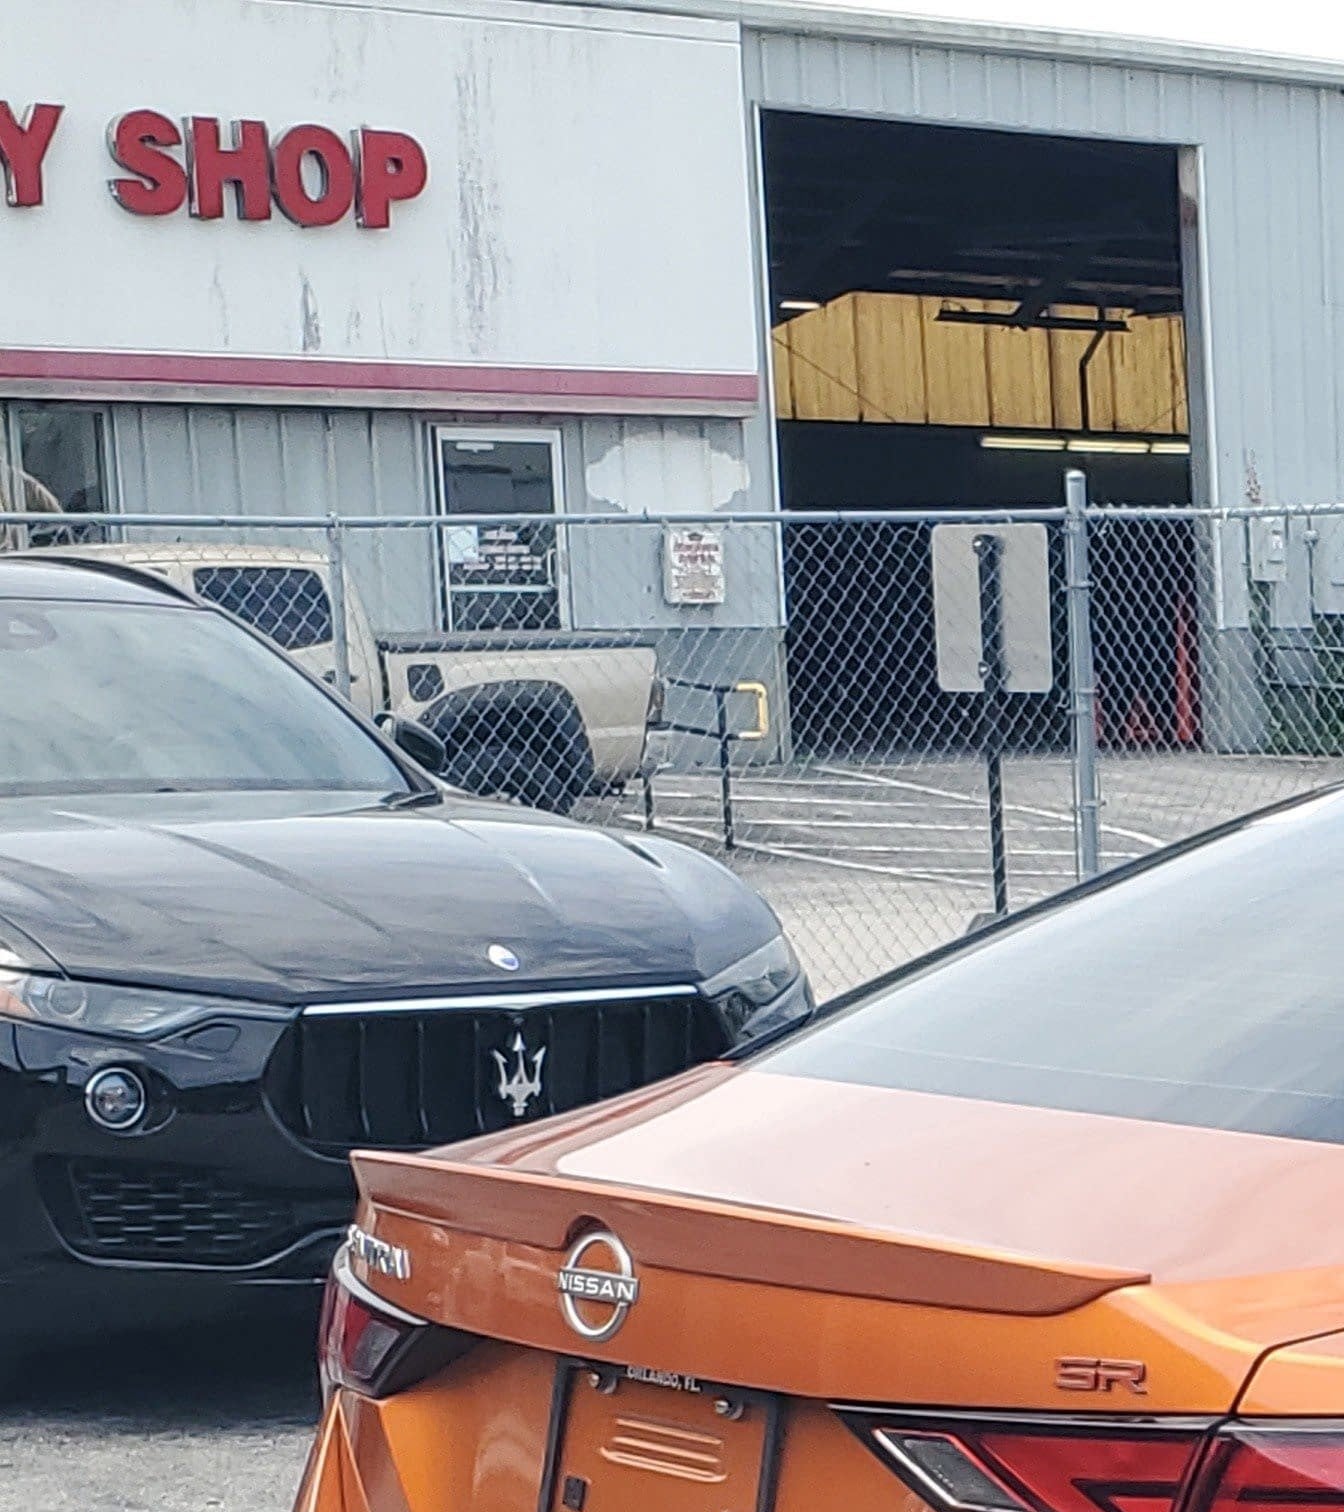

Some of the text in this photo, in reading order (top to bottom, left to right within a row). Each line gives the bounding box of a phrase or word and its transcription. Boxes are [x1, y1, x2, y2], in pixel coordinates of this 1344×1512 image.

[106, 109, 428, 229] SHOP
[559, 1271, 635, 1301] NISSAN
[1054, 1356, 1148, 1396] SR
